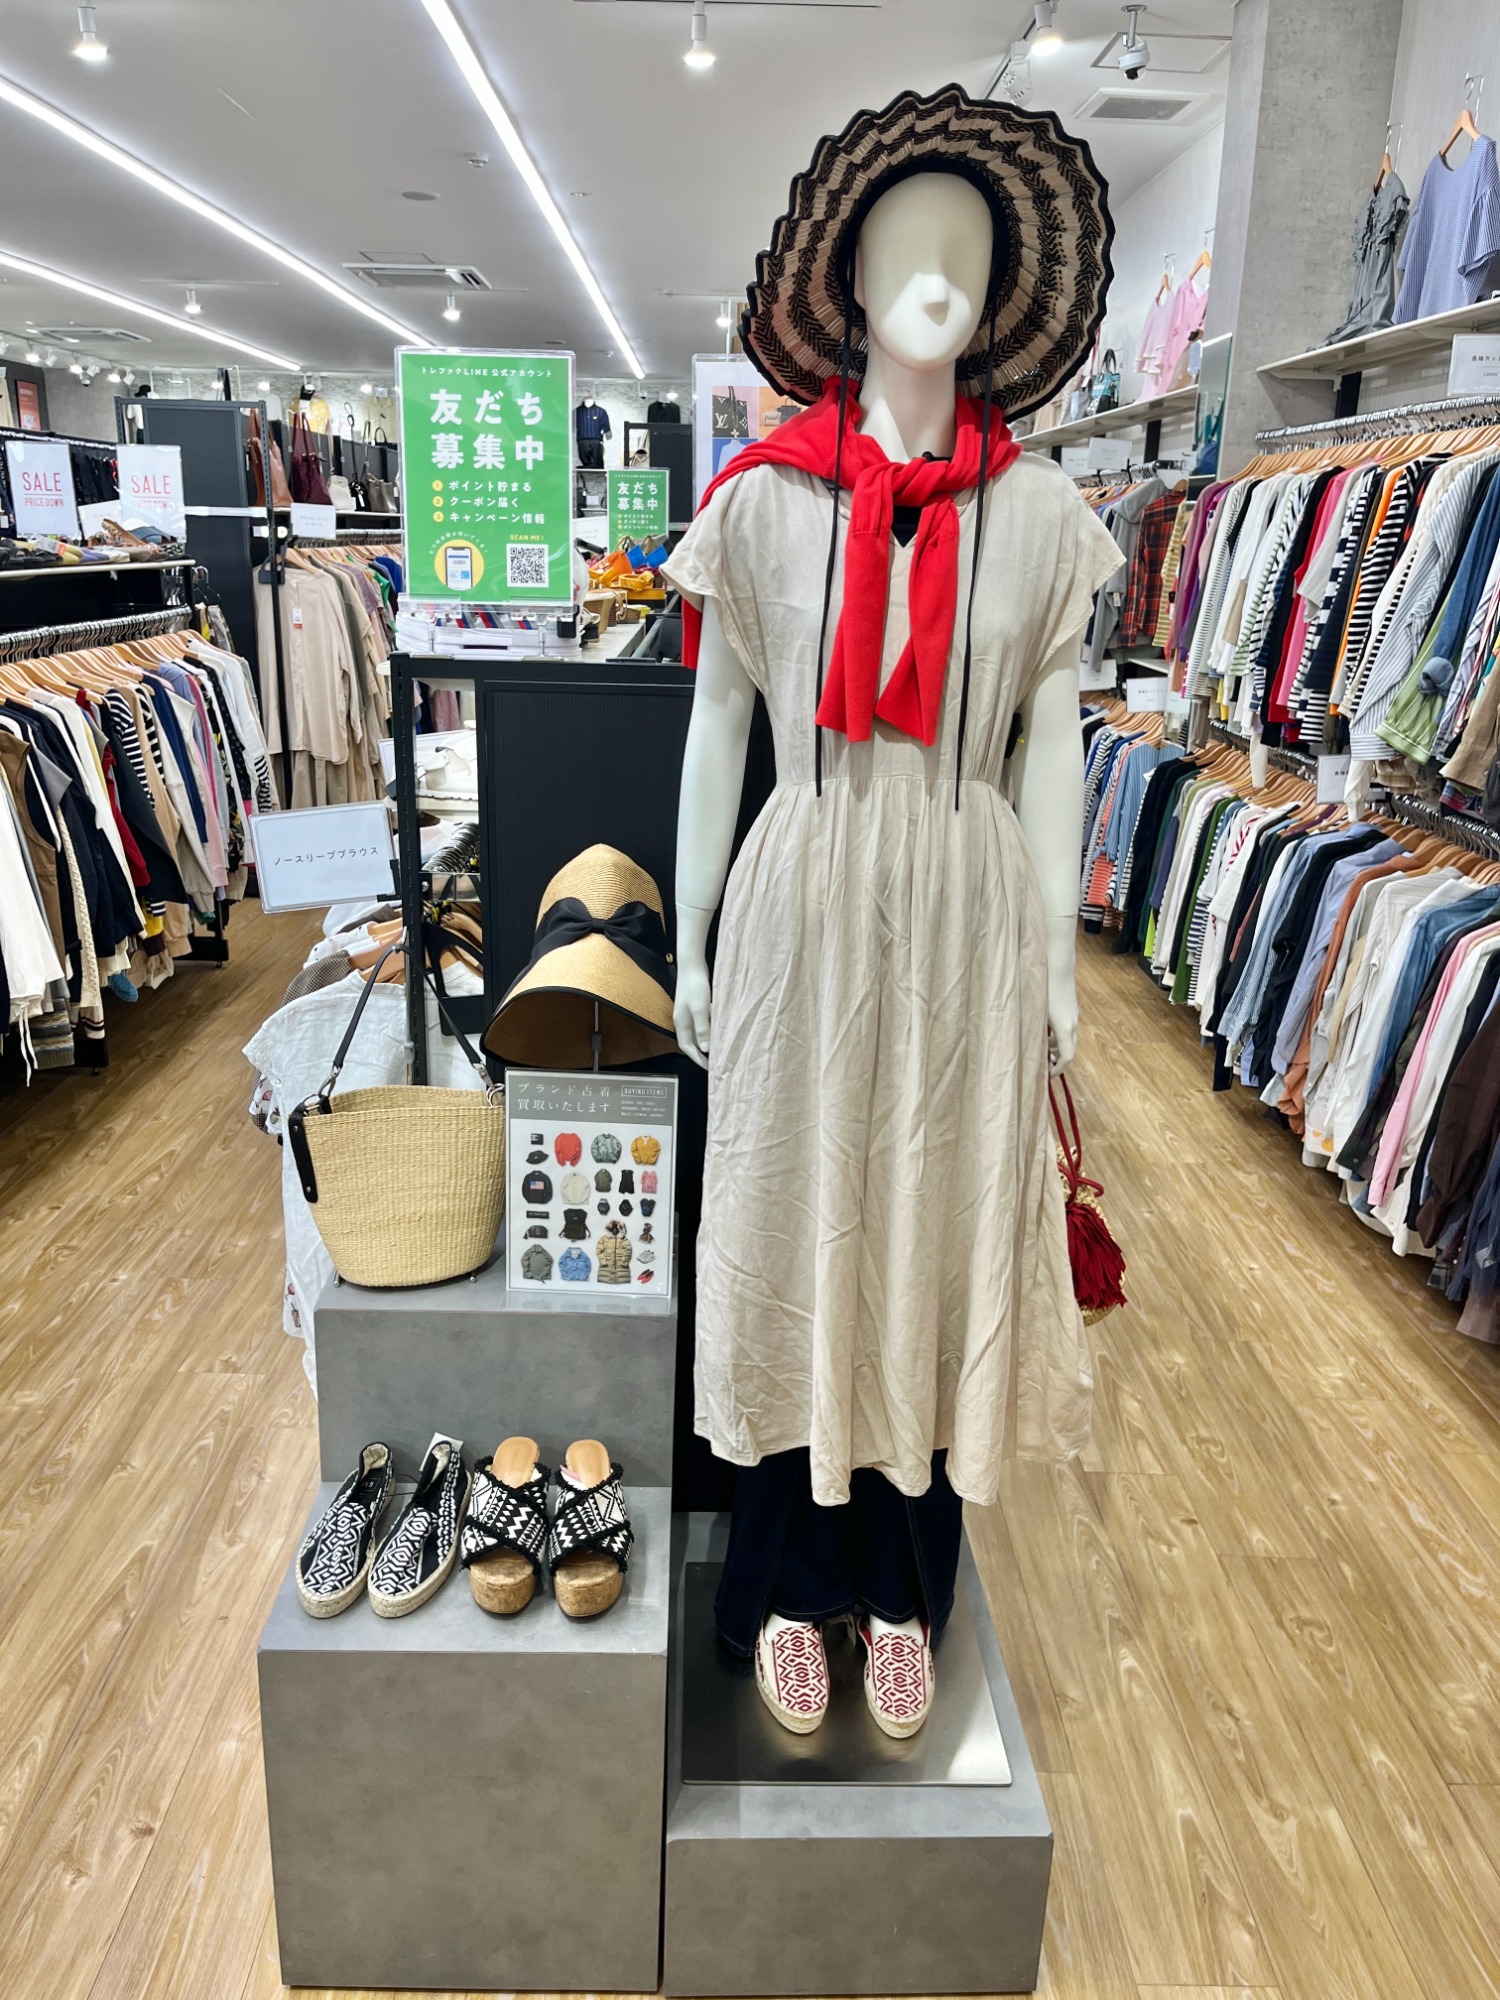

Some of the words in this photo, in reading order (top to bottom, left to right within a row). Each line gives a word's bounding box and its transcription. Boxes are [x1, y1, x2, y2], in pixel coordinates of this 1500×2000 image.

[430, 389, 543, 426] 友だち
[431, 433, 544, 470] 募集中
[22, 472, 63, 492] SALE
[131, 475, 171, 495] SALE
[449, 480, 532, 493] ポイント貯まる
[617, 482, 658, 495] 友だち
[450, 496, 518, 508] クーポン届く
[450, 512, 545, 525] キャンペーン情報
[274, 846, 379, 866] ノースリーブブラウス
[518, 1083, 611, 1098] ブランド古着
[517, 1098, 611, 1113] 買取いたします
